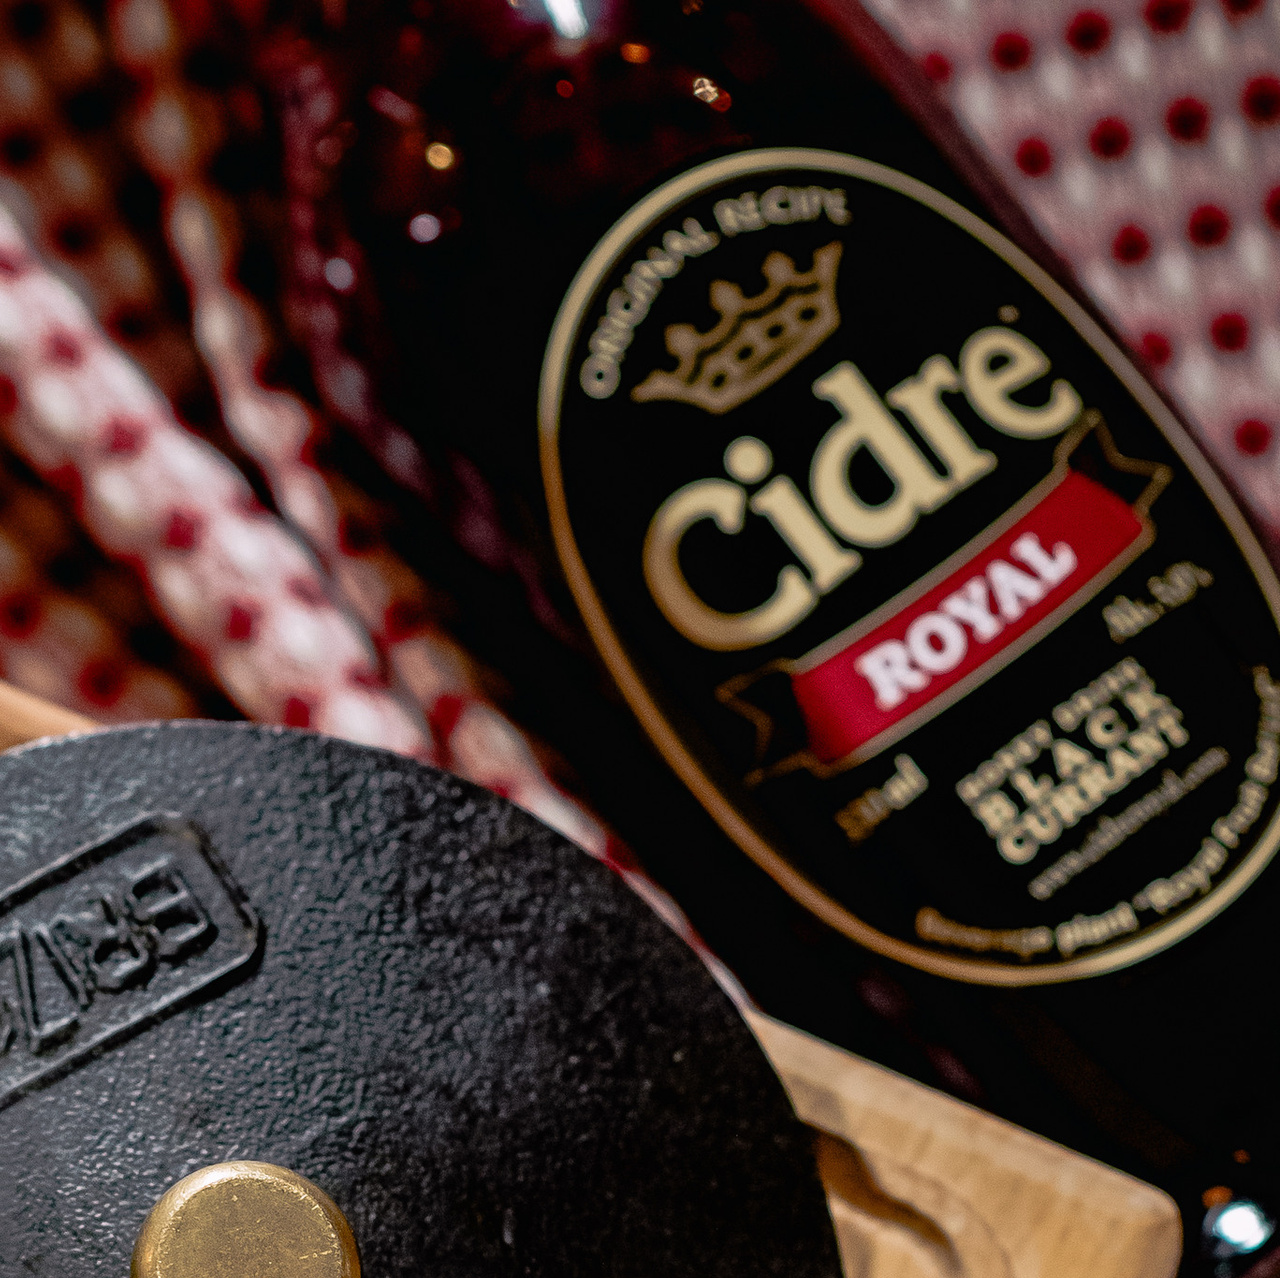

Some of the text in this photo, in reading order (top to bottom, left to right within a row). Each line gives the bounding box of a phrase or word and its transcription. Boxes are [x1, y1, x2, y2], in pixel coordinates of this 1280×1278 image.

[579, 185, 853, 400] ORIGINAL RECIPE
[643, 326, 1083, 651] Cidre
[855, 532, 1078, 713] ROYAL
[977, 680, 1185, 838] BLACK
[996, 708, 1190, 866] CURRANT
